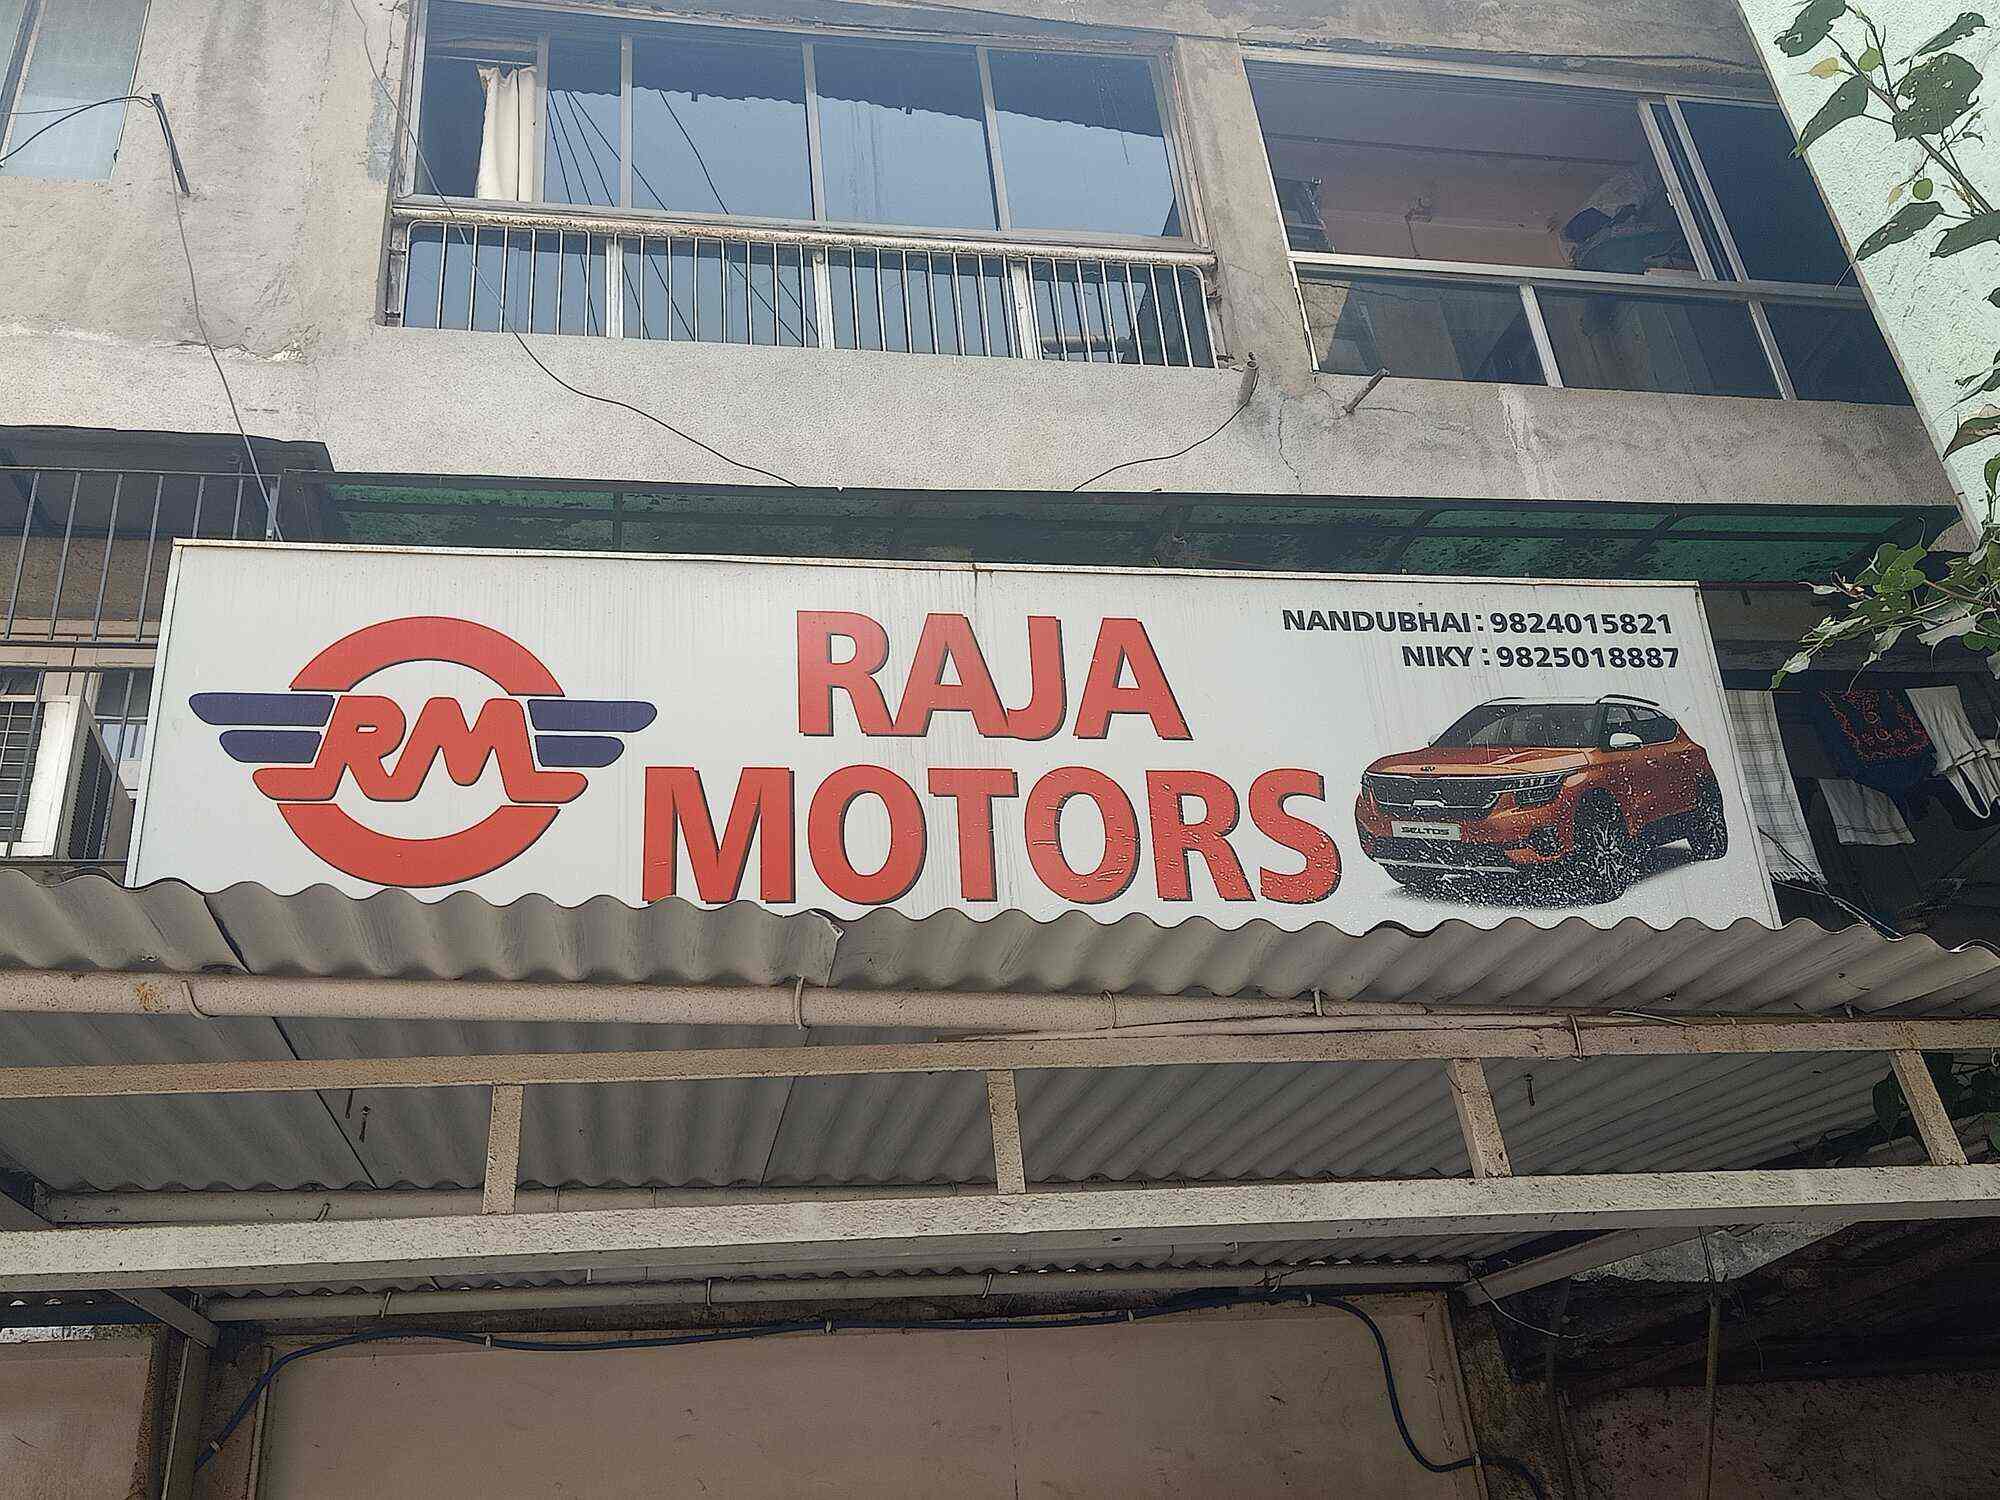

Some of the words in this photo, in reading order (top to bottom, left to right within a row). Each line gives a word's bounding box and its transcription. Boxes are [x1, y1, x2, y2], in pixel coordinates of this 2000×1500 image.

[797, 610, 1193, 741] RAJA
[1490, 612, 1672, 634] 9824015821
[1497, 646, 1679, 668] 9825018887
[252, 694, 589, 804] RM
[643, 764, 1342, 905] MOTORS
